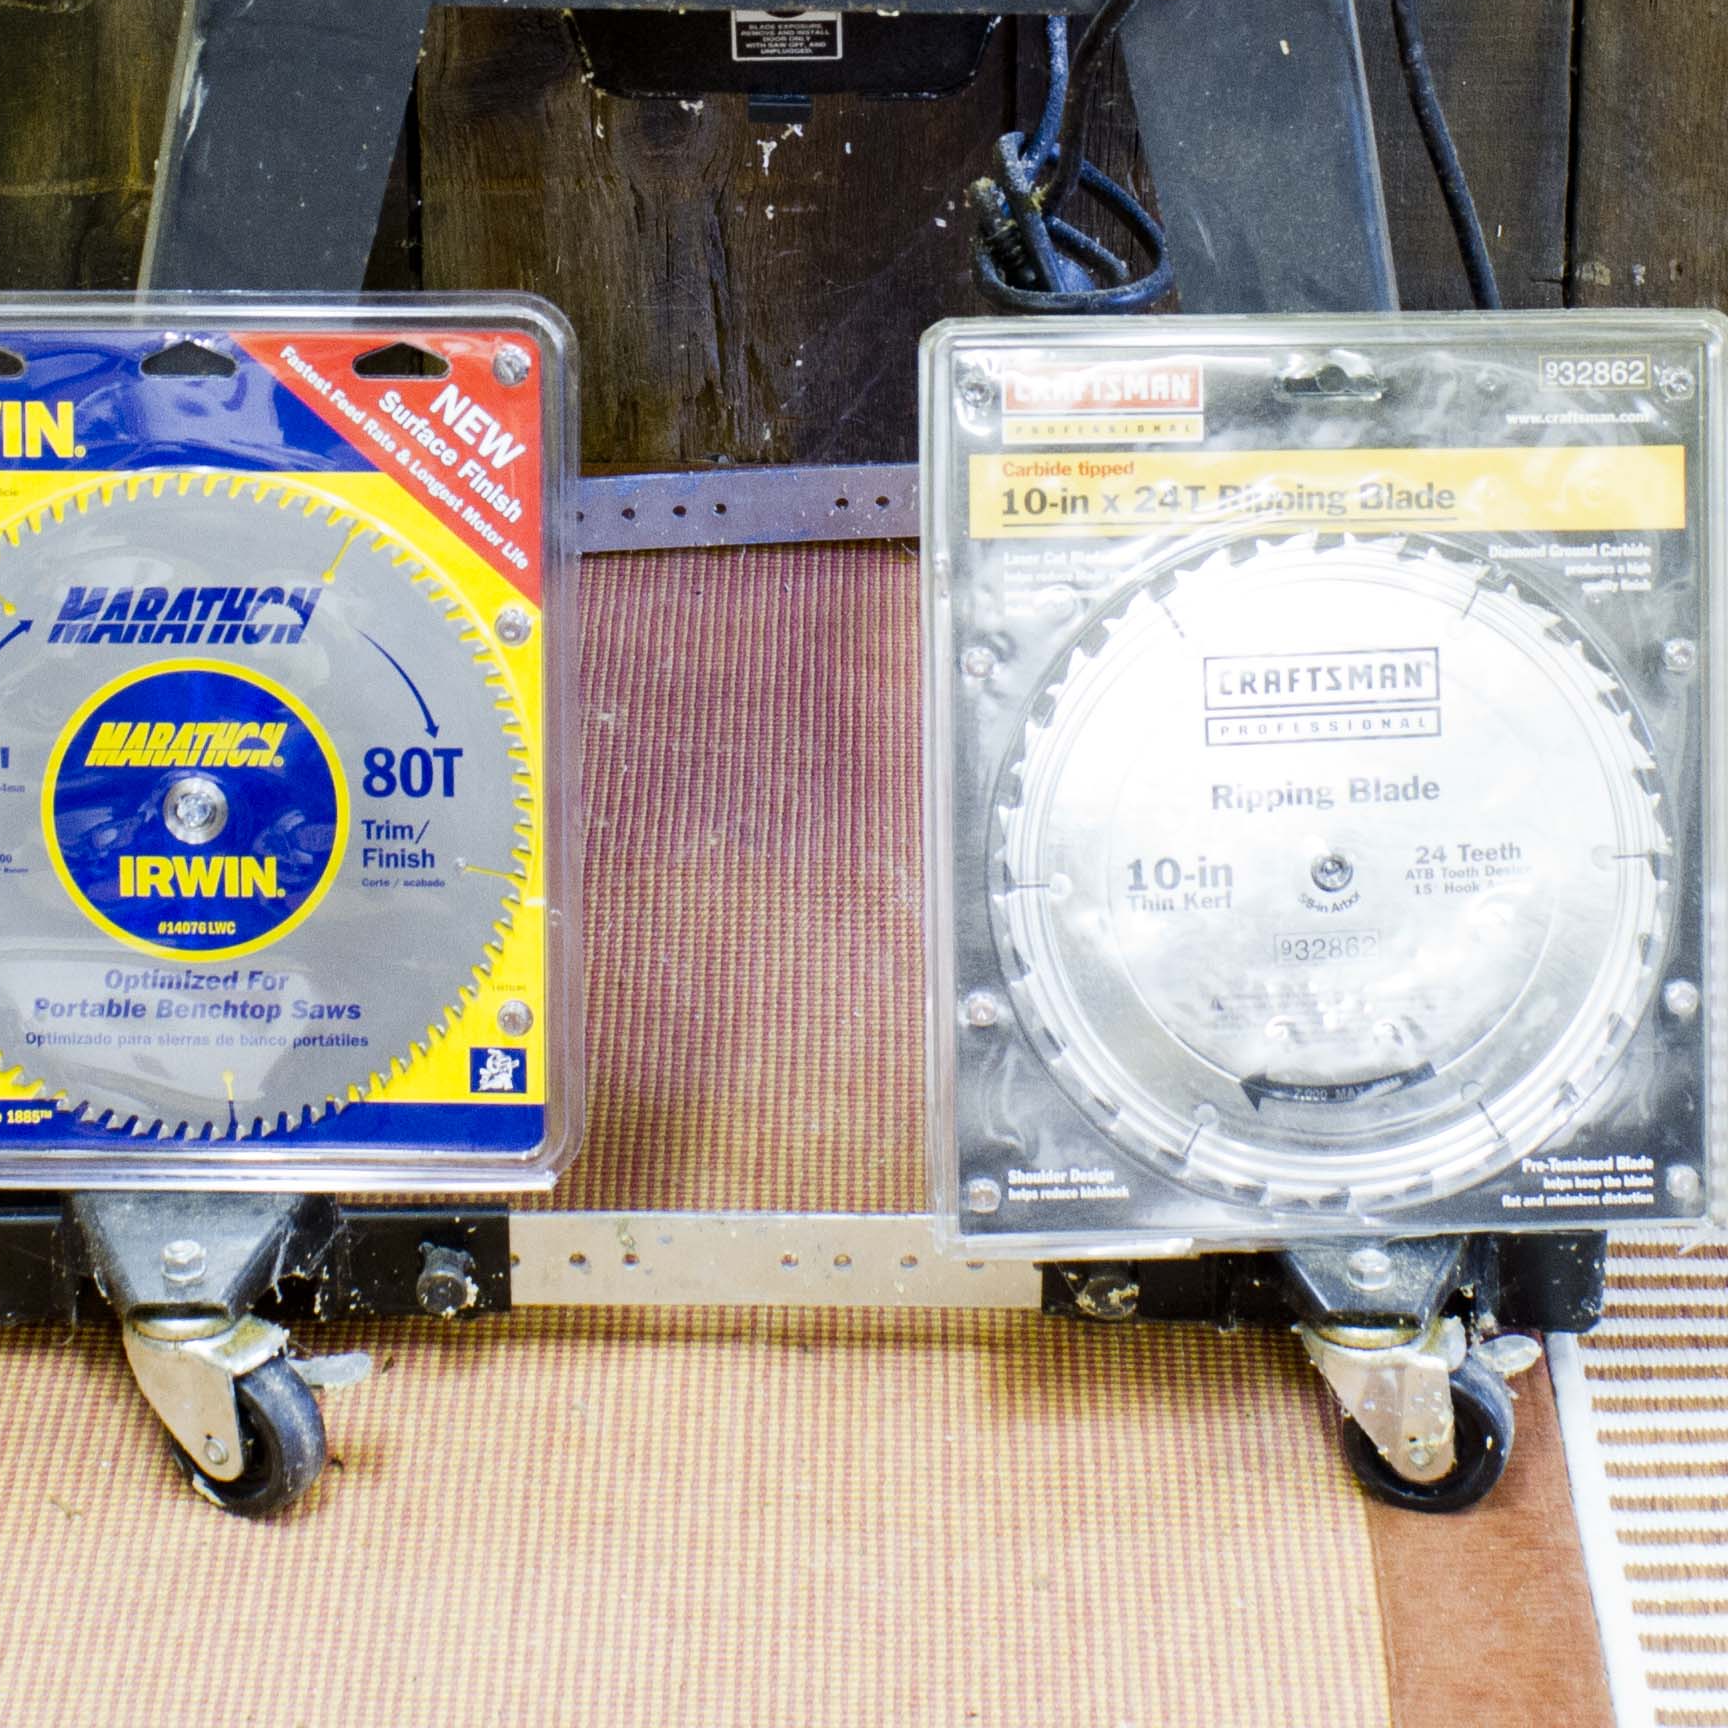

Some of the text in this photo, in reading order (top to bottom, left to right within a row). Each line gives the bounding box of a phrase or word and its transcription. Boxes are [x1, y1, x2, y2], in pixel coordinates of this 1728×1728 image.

[1546, 360, 1644, 384] 932862
[429, 384, 526, 469] NEW
[1505, 413, 1649, 424] www.craftsman.com
[1016, 425, 1190, 433] PROFESSIONAL
[280, 345, 528, 570] Fastest Feed Rate & Longest Motor Life
[379, 389, 522, 523] Surface Finish
[1002, 462, 1134, 478] Carbide tipped
[1002, 482, 1456, 515] 10-in x 24T Ripping Blade
[1488, 543, 1650, 559] Diamond Ground Carbide
[48, 586, 322, 644] MARATHON
[1219, 663, 1422, 695] CRAFTSMAN
[1220, 717, 1424, 736] PROFESSIONAL
[363, 747, 463, 798] 80T
[1211, 774, 1440, 813] Ripping Blade
[362, 820, 430, 844] Trim/
[362, 848, 434, 868] Finish
[1415, 843, 1521, 864] 24 Teeth
[362, 878, 445, 887] Corte acabado
[1127, 856, 1233, 891] 10-in
[1405, 867, 1479, 880] ATB Tooth
[1444, 882, 1479, 894] Hook
[1126, 891, 1232, 911] Thin Kerf
[1281, 936, 1376, 960] 932862
[105, 969, 289, 992] Optimized For
[34, 998, 361, 1022] Portable Benchtop Saws
[26, 1032, 368, 1049] Optimizado para sierras de banco portátiles
[1522, 1156, 1654, 1172] Pre-Tensioned Blade
[1008, 1168, 1114, 1184] Shoulder Design
[1543, 1174, 1654, 1191] helps keep the blade
[1008, 1185, 1129, 1202] helps reduce kickback
[1502, 1192, 1654, 1207] flat and minimizes distortion
